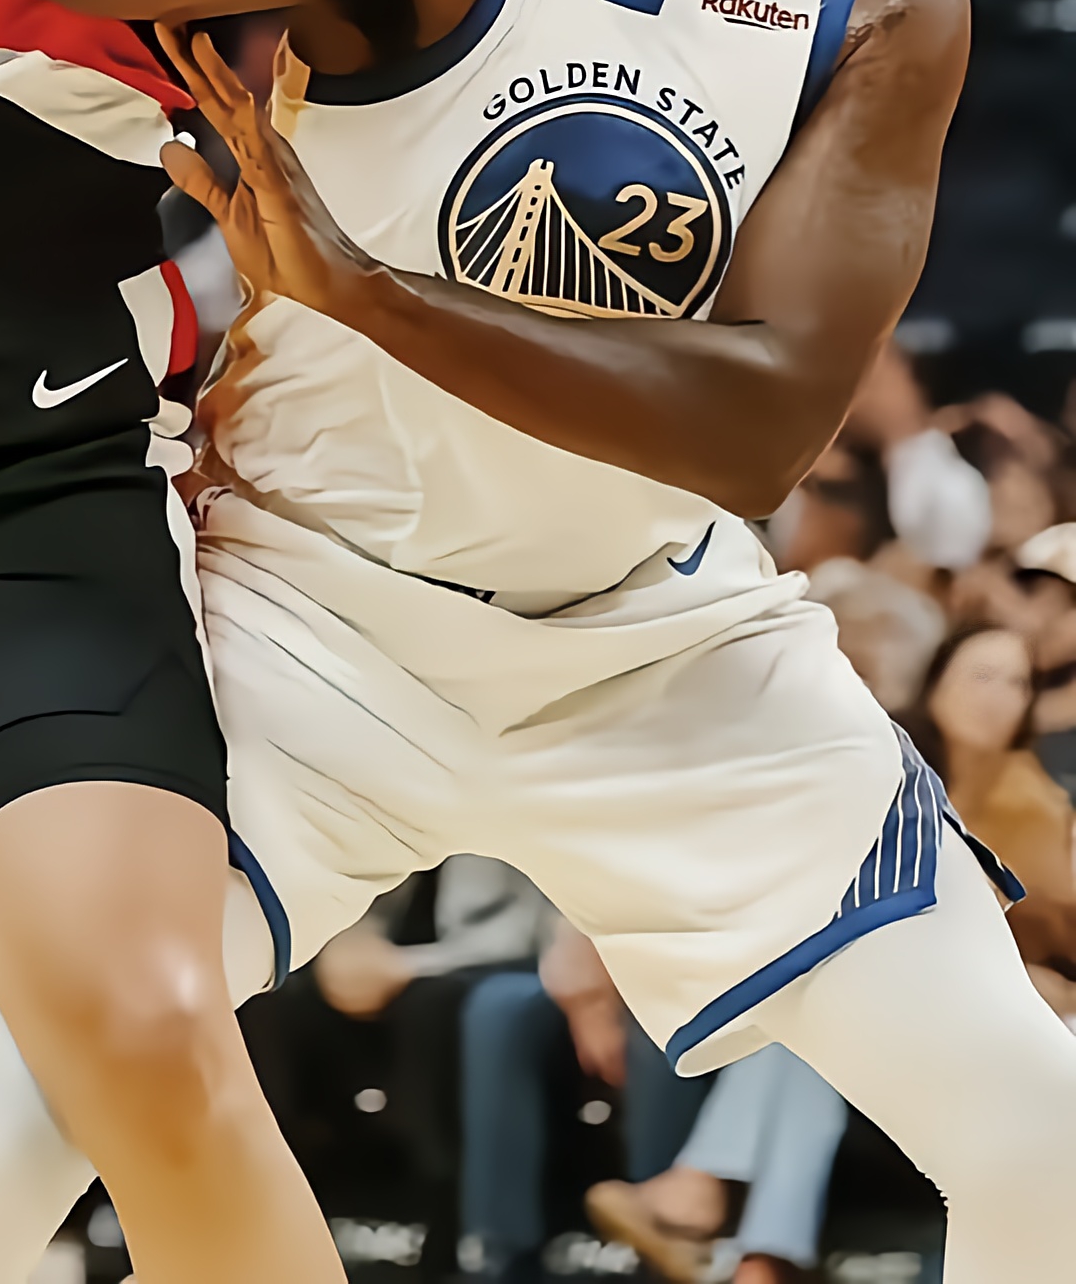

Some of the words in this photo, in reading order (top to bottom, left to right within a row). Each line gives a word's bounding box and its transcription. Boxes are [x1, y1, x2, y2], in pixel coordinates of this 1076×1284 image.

[482, 61, 641, 120] GOLDEN
[656, 86, 746, 190] STATE
[597, 183, 709, 262] 23
